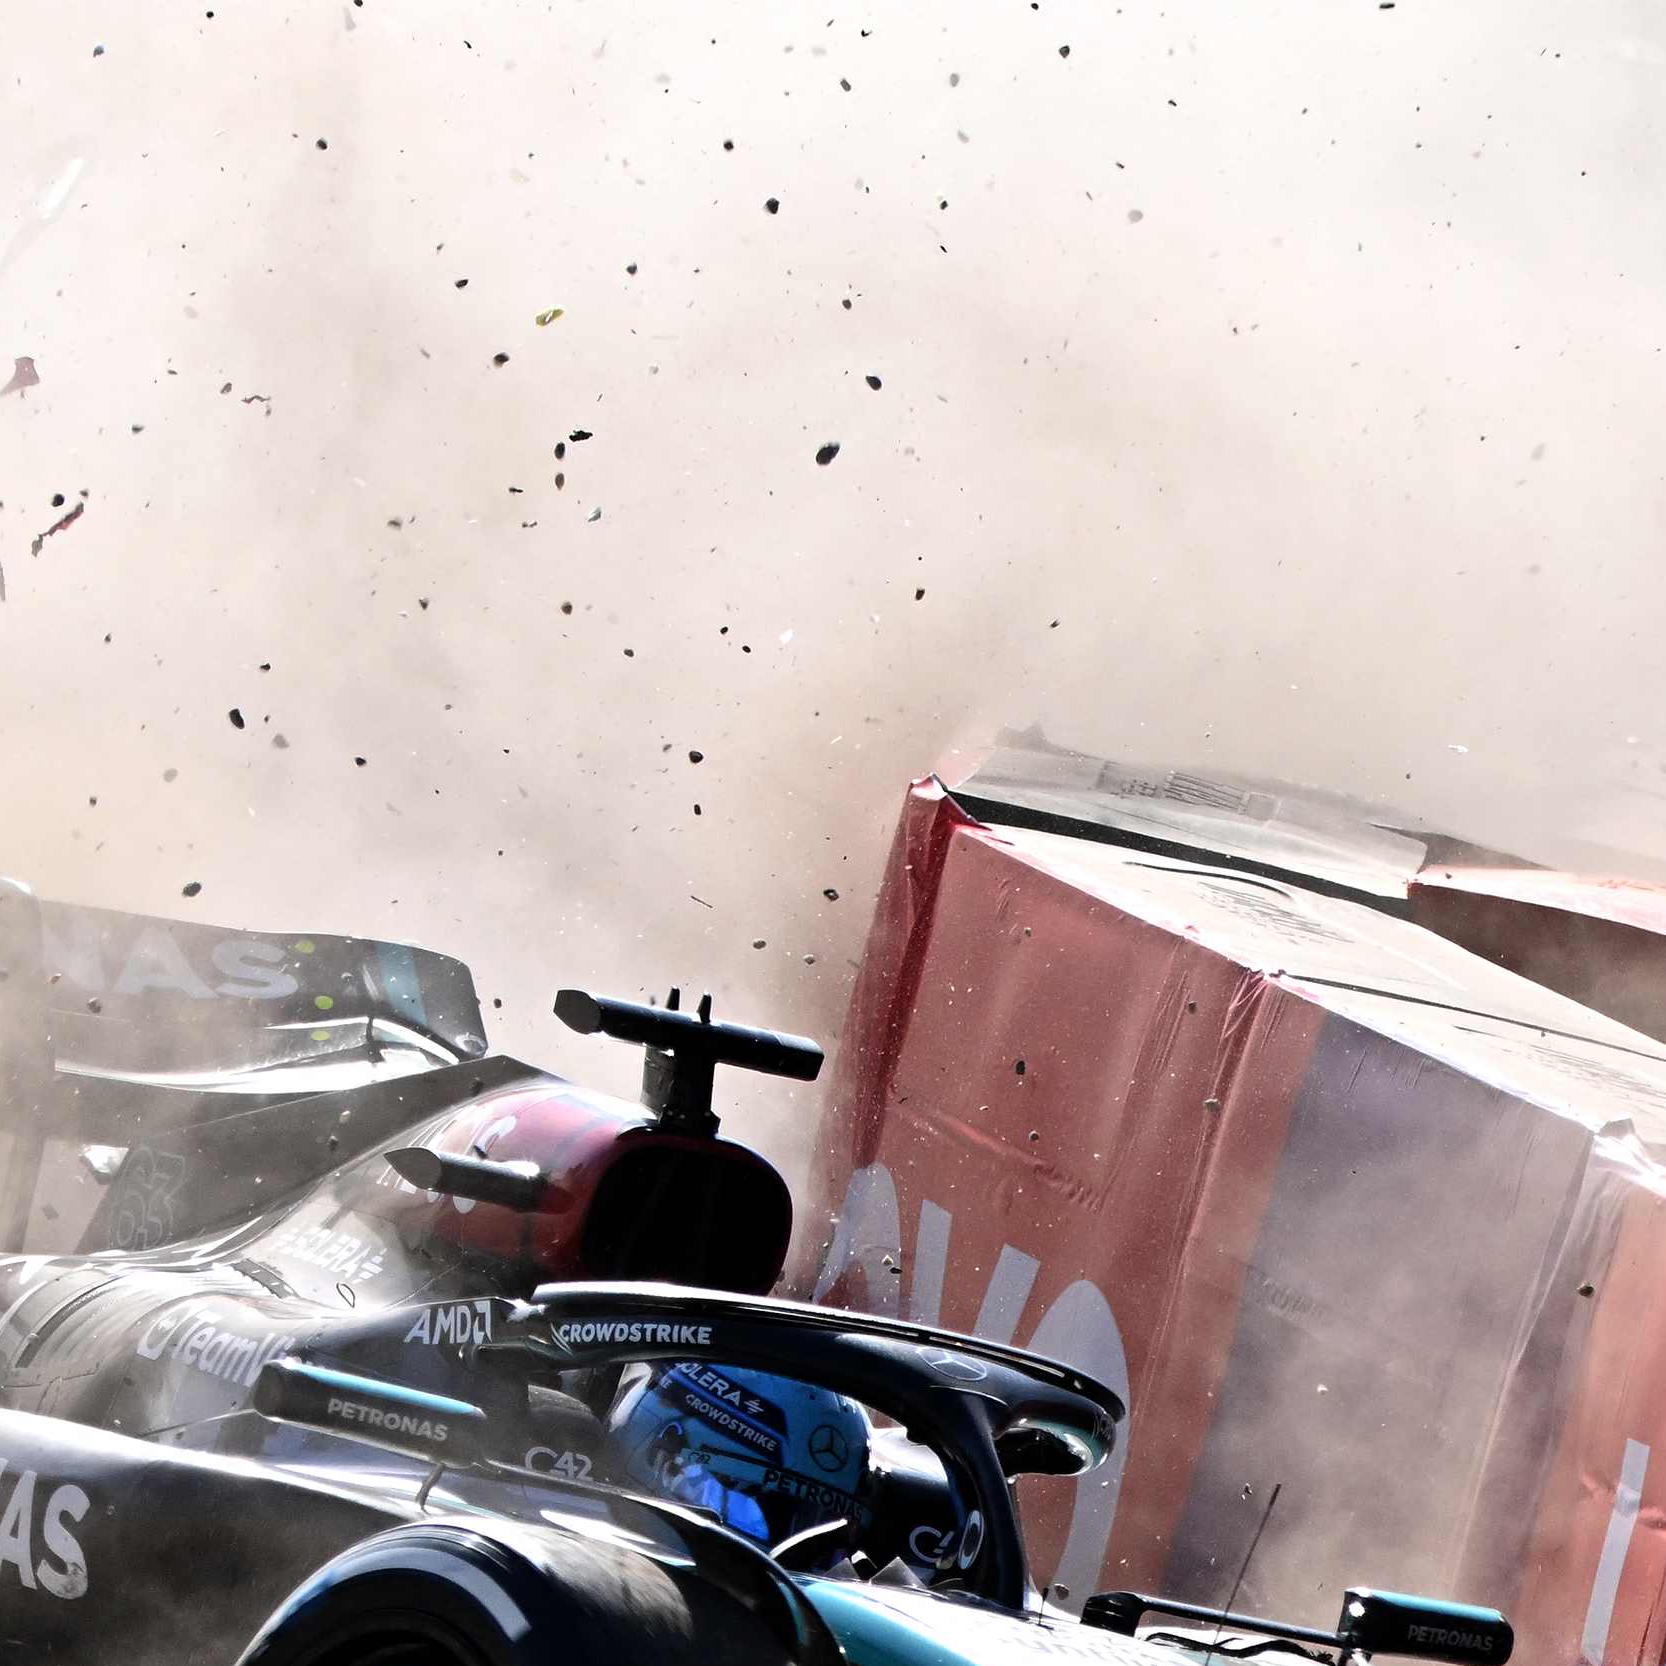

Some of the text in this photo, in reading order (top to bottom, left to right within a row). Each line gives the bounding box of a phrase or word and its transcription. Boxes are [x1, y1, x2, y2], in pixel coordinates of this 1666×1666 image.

[558, 1322, 711, 1346] CROWDSTRIKE
[328, 1398, 448, 1442] PETRONAS
[684, 1393, 777, 1451] CROWDSTRIKE
[1406, 1624, 1494, 1652] PETRONAS
